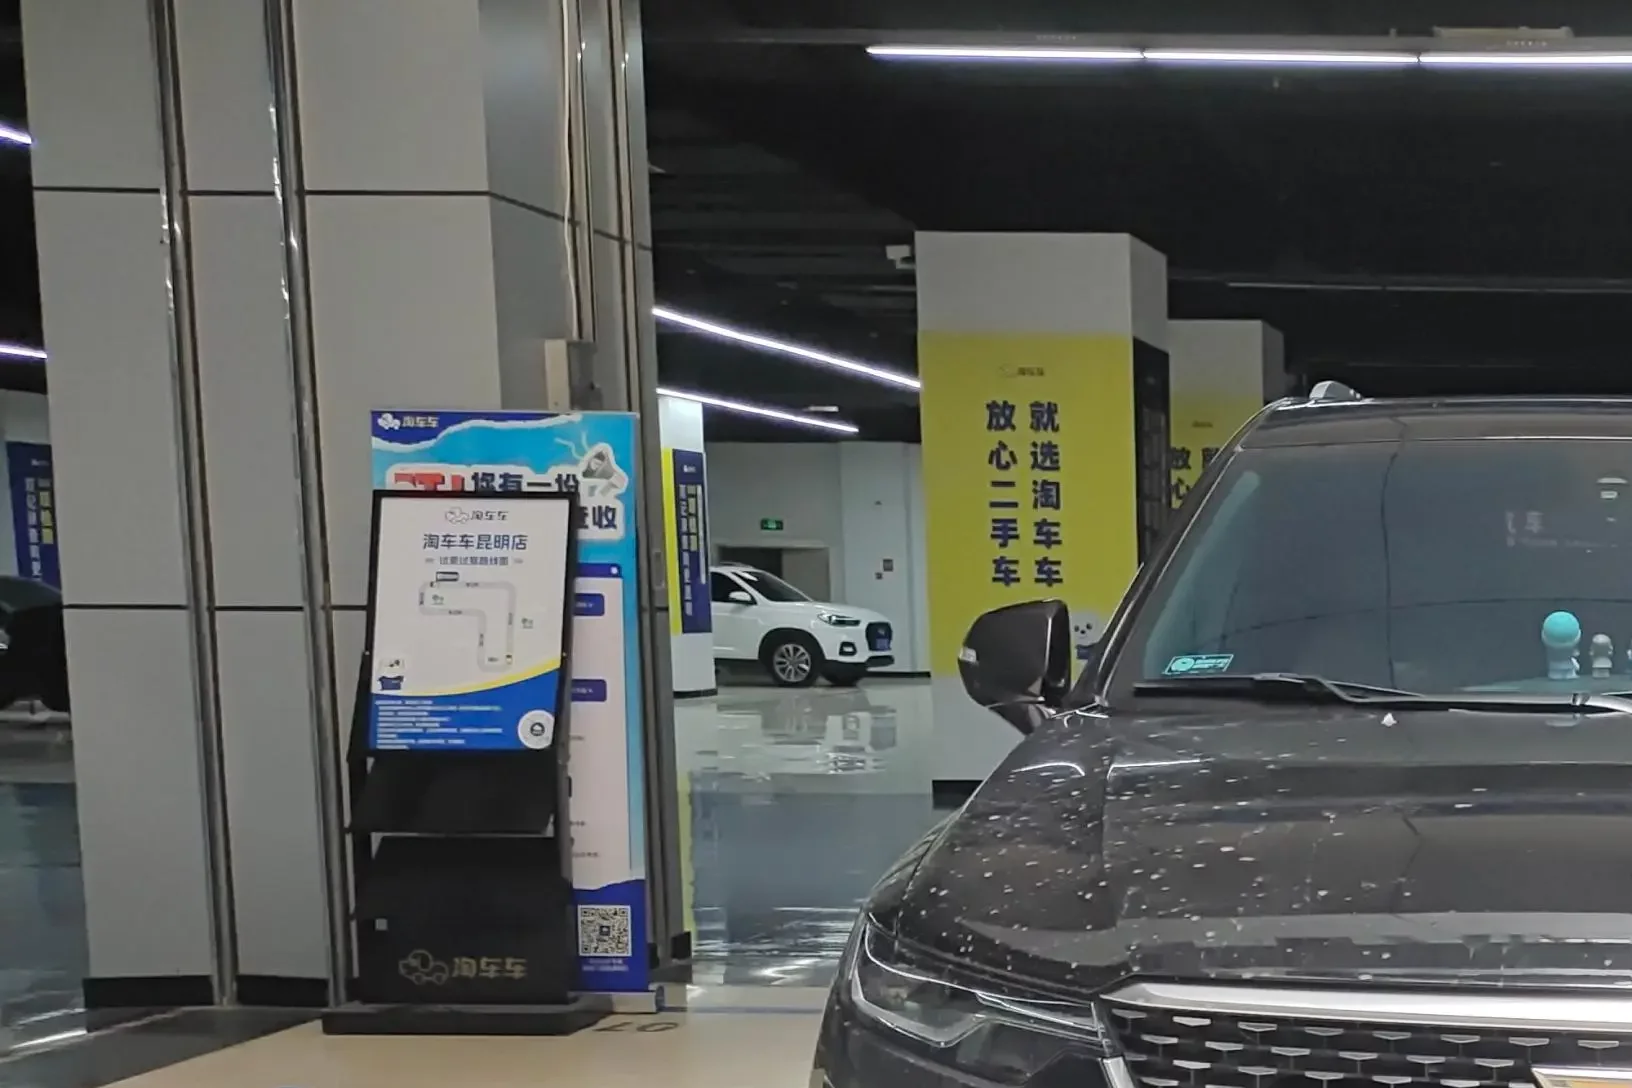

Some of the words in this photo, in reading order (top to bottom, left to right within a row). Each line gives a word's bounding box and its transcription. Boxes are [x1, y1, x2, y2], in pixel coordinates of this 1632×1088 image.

[423, 533, 528, 551] 淘车车昆明店
[986, 400, 1020, 587] 放心二手车
[1029, 400, 1063, 587] 就选淘车车
[452, 956, 527, 980] 淘车车
